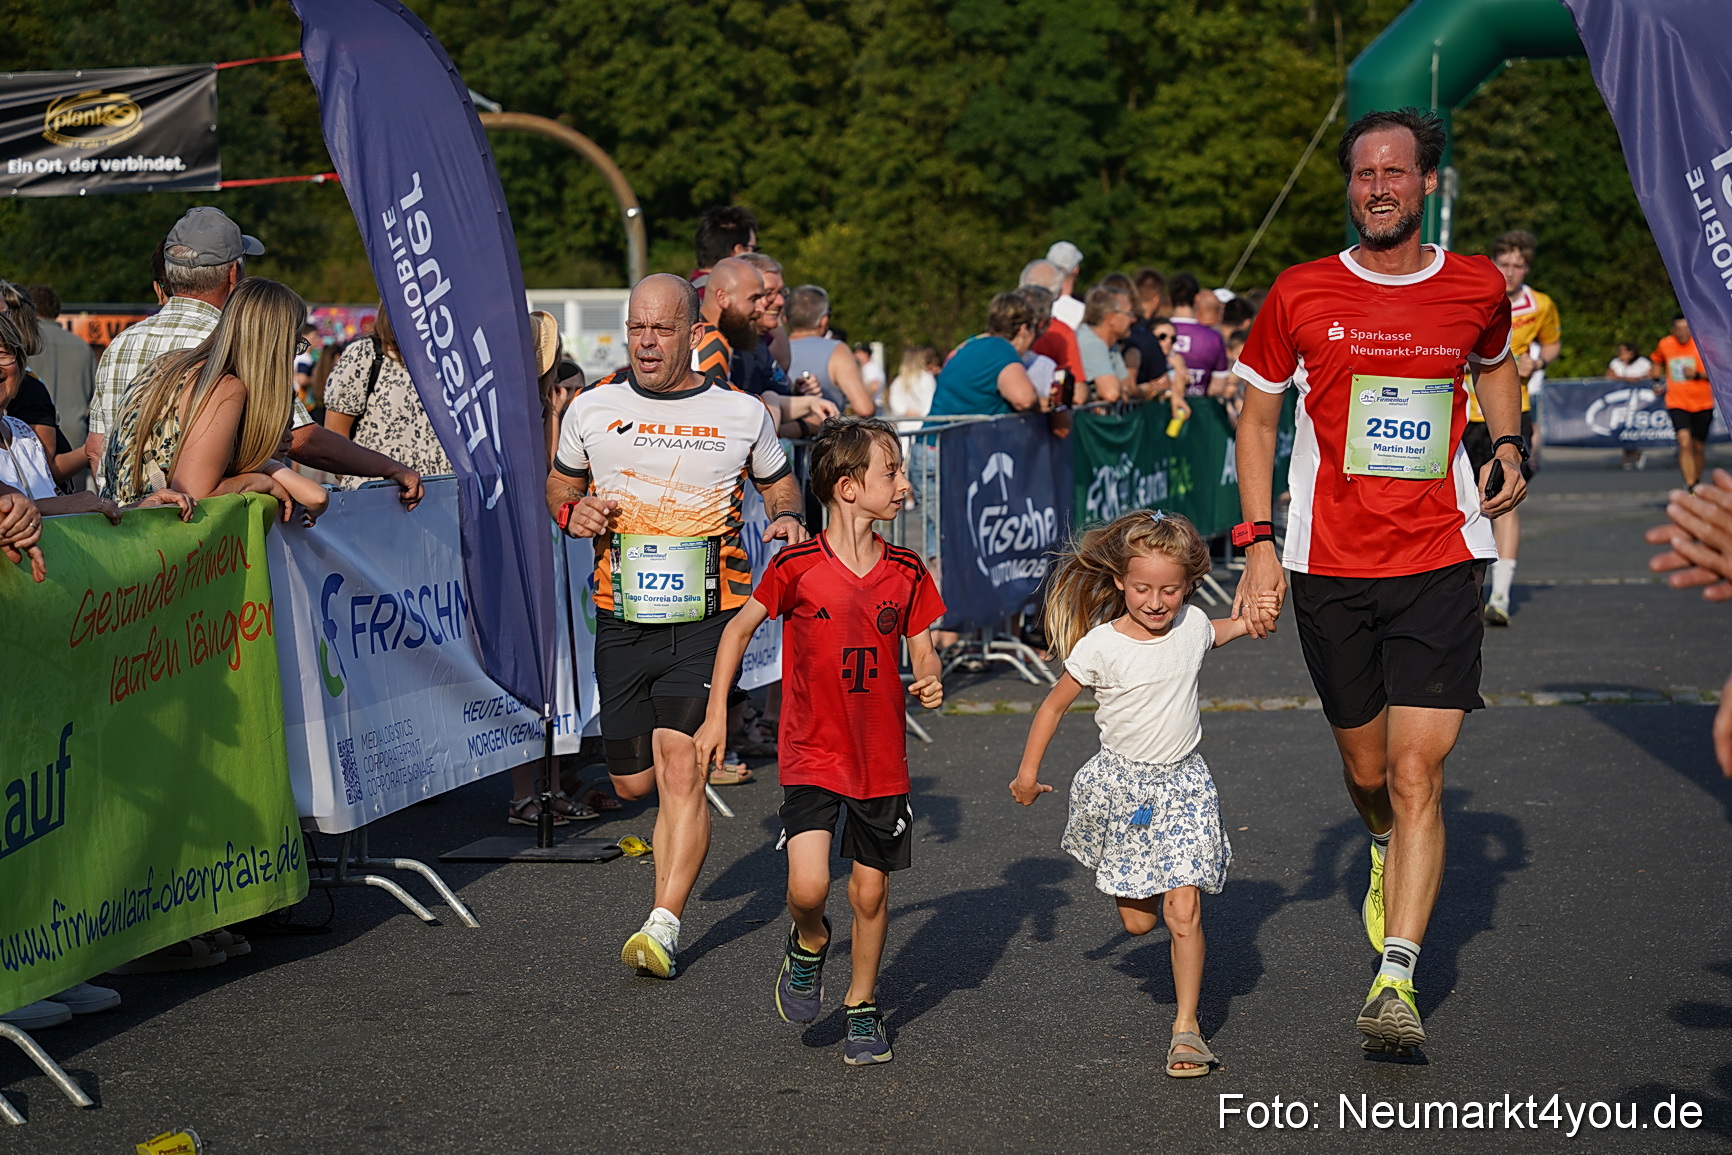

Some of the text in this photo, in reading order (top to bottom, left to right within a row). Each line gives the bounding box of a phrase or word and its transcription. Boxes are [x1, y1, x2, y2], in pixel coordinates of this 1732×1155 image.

[7, 154, 187, 175] Ein Ort, der verbindet.
[1350, 329, 1412, 341] Sparkasse
[1350, 345, 1461, 359] Neumarkt-Parsberg
[637, 423, 727, 439] KLEBL
[1366, 418, 1431, 440] 2560
[633, 436, 726, 452] DYNAMICS
[1373, 443, 1425, 454] Martin Iberl
[636, 571, 685, 591] 1275
[69, 548, 178, 649] Gesunde
[625, 592, 642, 602] Tiago
[643, 594, 671, 602] Correia
[683, 594, 702, 602] Silva
[110, 597, 273, 706] laufen länger
[463, 696, 503, 724] HEUTE
[467, 726, 508, 759] MORGEN
[367, 766, 407, 797] CORPORATE
